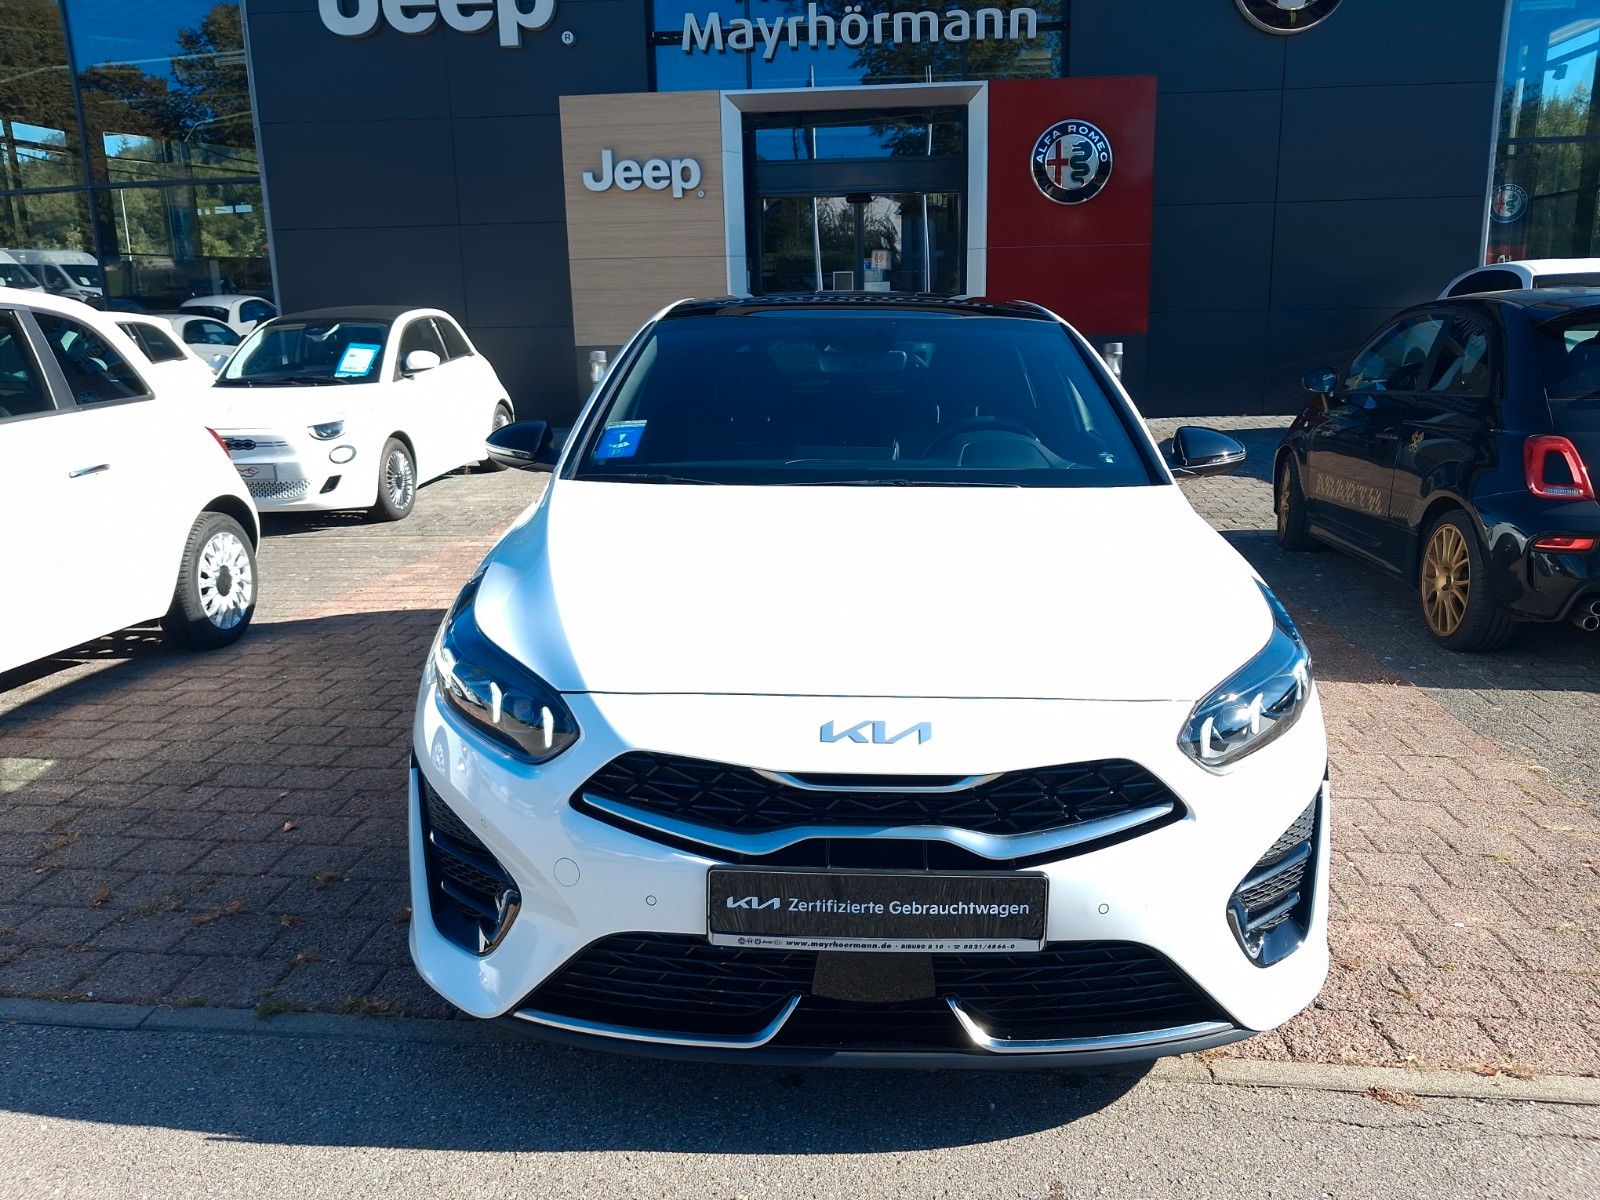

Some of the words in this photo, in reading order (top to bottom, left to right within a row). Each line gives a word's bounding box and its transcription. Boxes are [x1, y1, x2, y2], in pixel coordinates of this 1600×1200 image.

[681, 2, 1038, 60] Mayrhörmann
[1036, 130, 1062, 163] ALFA
[1067, 124, 1108, 162] ROMEO
[582, 149, 701, 199] Jeep
[820, 720, 932, 745] KIA
[726, 896, 780, 909] KIA
[788, 898, 884, 914] Zertifizierte
[889, 901, 1029, 917] Gebrauchtwagen
[786, 940, 892, 949] www.mayrhoermann.de
